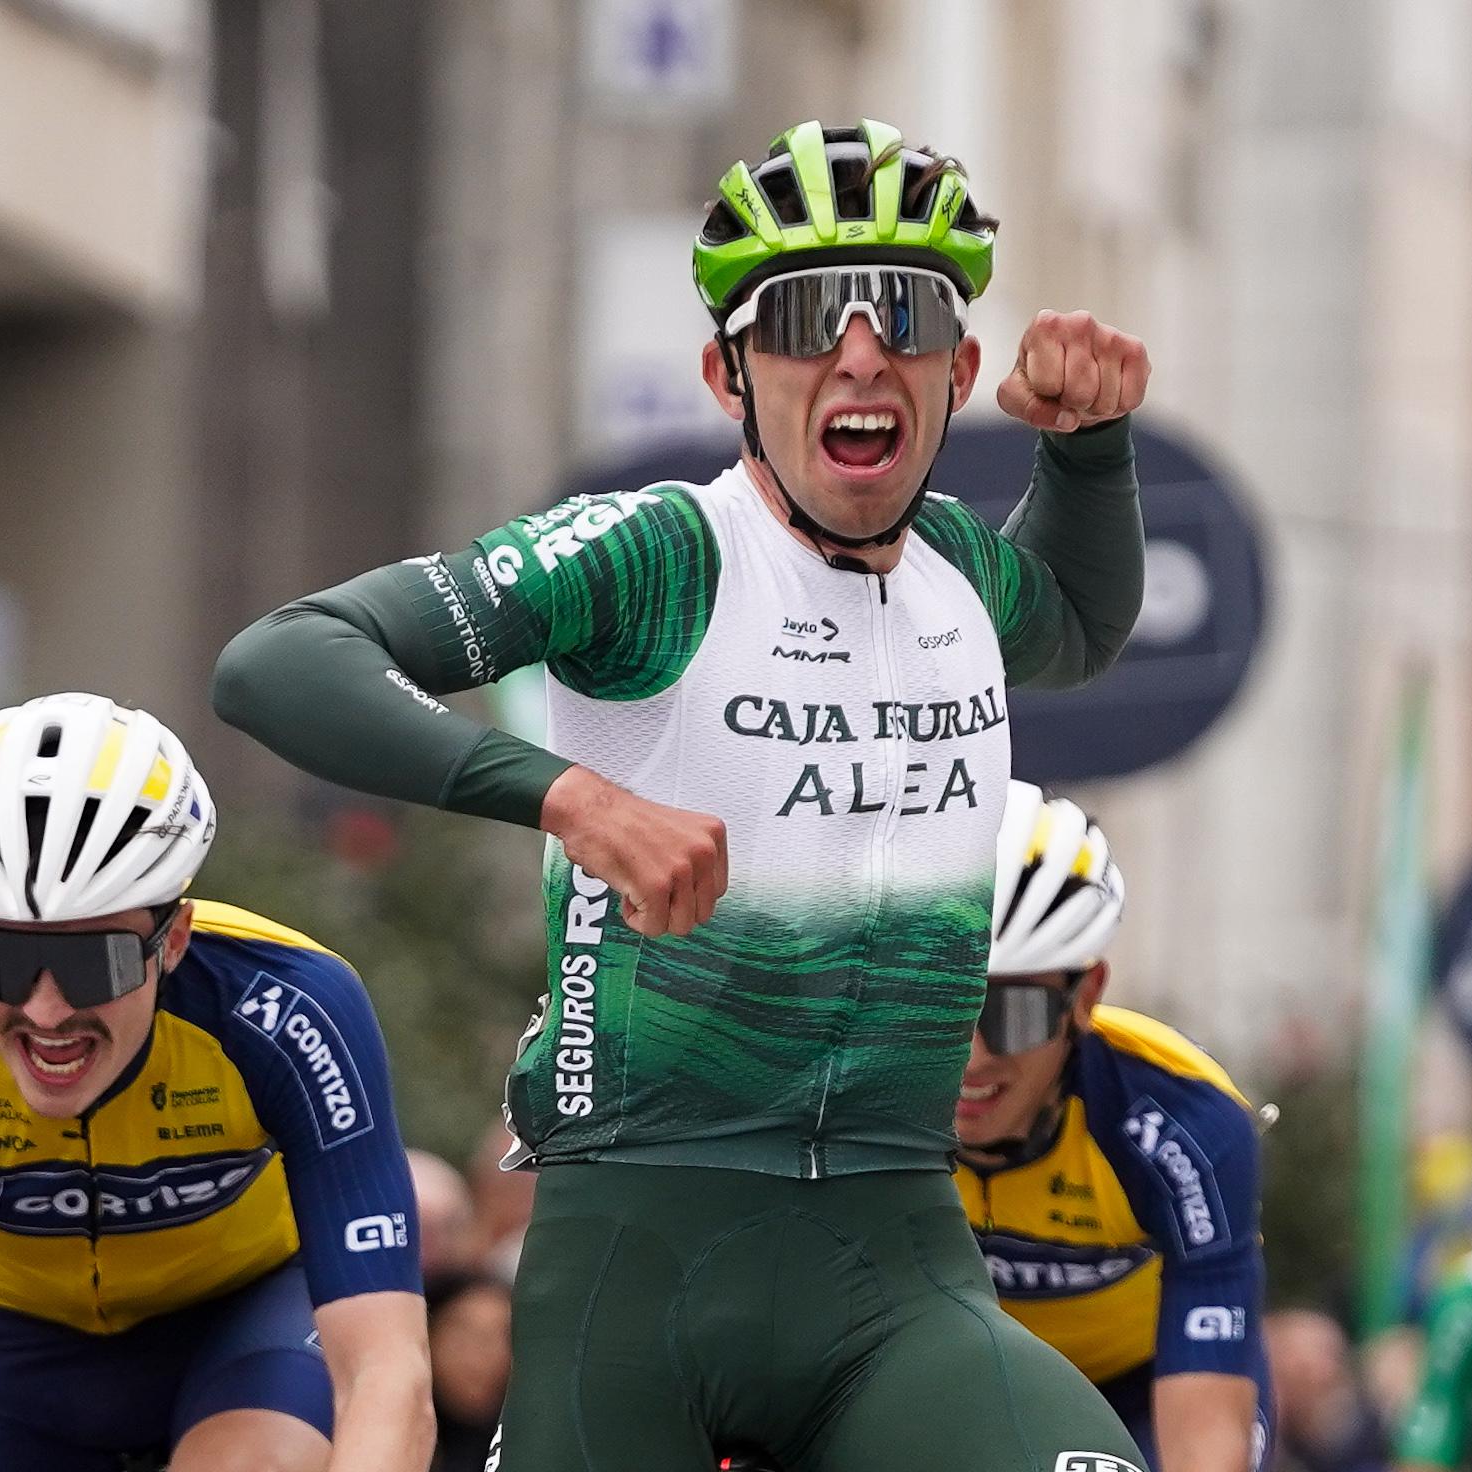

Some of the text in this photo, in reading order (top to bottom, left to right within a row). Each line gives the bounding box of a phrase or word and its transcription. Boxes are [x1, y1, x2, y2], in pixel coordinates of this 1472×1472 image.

[423, 565, 484, 678] NUTRITION
[918, 628, 962, 650] GSPORT
[771, 645, 852, 664] MMR
[385, 668, 450, 714] GSPORT
[723, 686, 1007, 746] CAJA RURAL
[775, 758, 978, 817] ALEA
[555, 954, 598, 1118] SEGUROS
[285, 1013, 357, 1131] CORTIZO
[14, 1163, 254, 1217] CORTIZO
